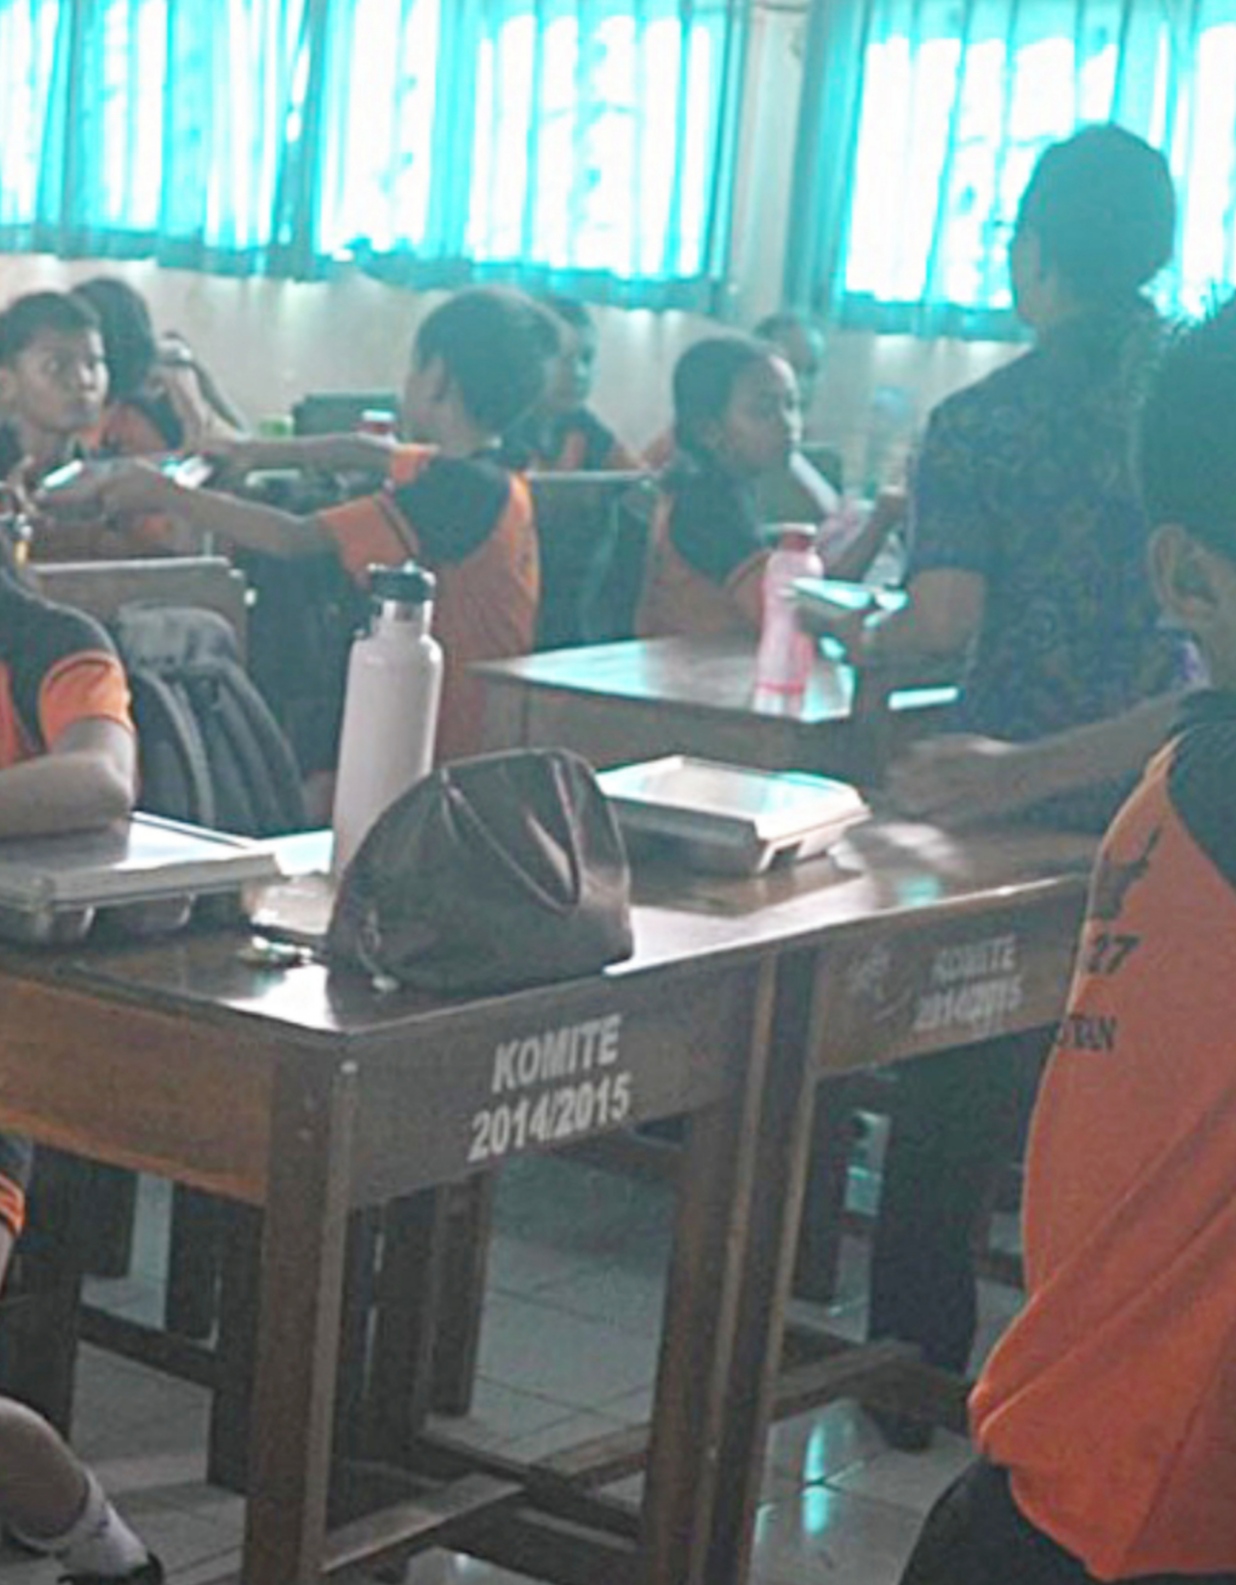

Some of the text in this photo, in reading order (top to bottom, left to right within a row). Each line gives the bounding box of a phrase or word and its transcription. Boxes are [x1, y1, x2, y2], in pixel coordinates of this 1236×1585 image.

[492, 1013, 622, 1093] KOMITE
[1058, 1014, 1117, 1052] TAN
[467, 1070, 632, 1162] 2014/2015
